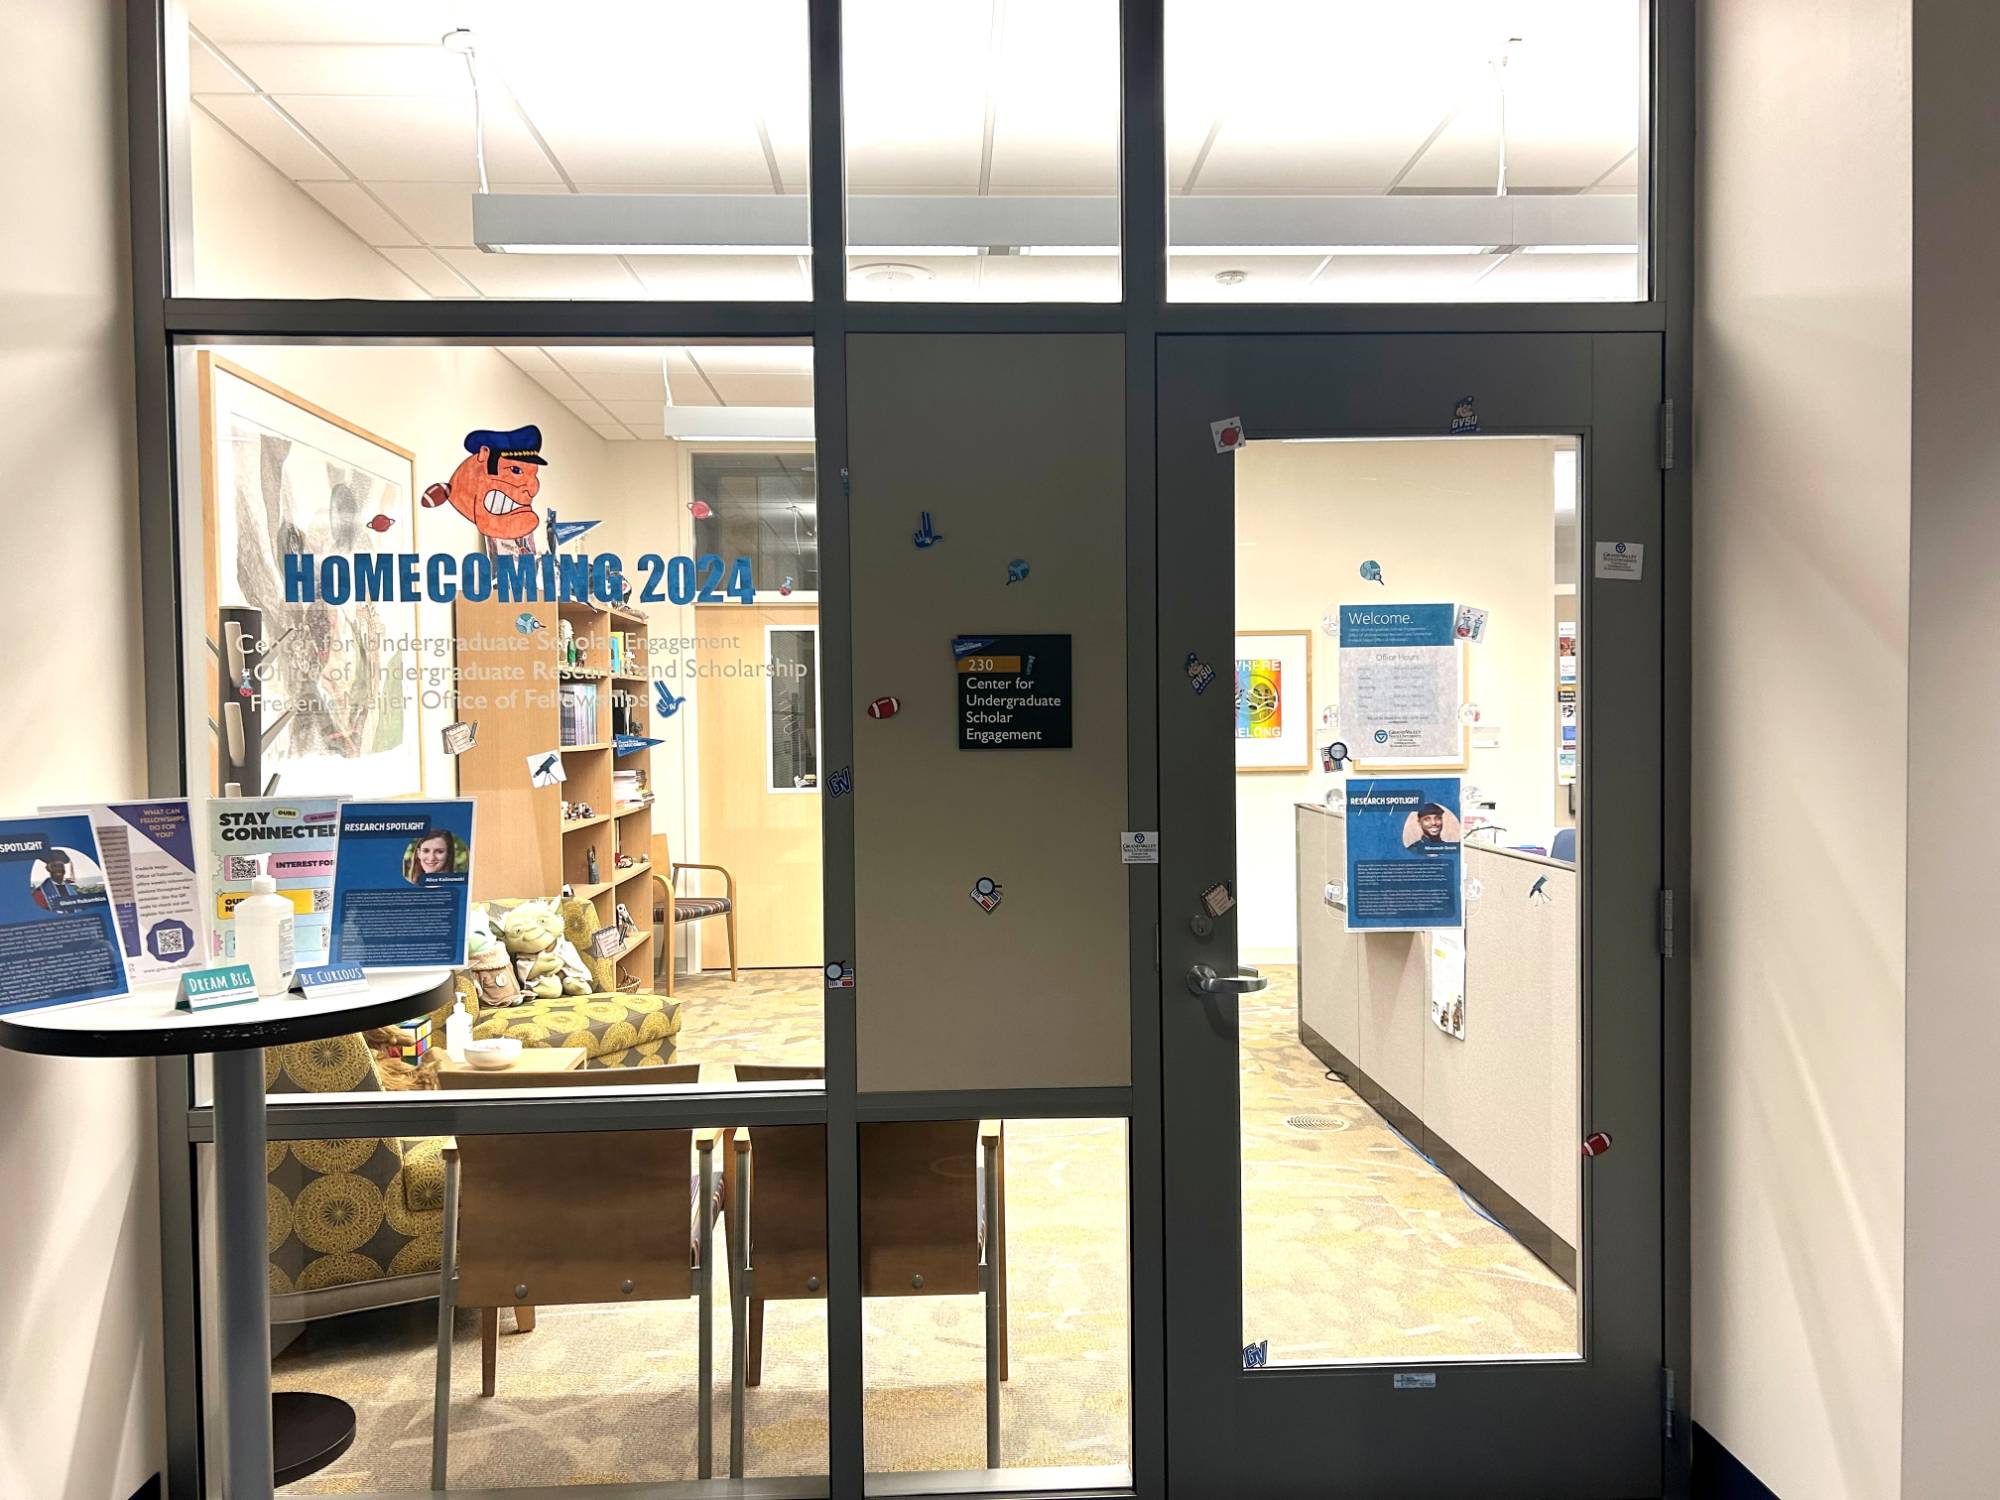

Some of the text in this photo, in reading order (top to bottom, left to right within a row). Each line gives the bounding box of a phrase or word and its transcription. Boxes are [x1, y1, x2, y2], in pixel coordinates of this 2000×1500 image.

[1452, 416, 1478, 428] GVSU
[284, 552, 756, 605] HOMECOMING 2024
[1349, 612, 1414, 625] Welcome.
[323, 633, 354, 653] for
[363, 632, 528, 662] Undergraduate
[537, 630, 611, 651] Scola
[625, 632, 740, 656] Engagement
[330, 662, 351, 681] of
[364, 662, 526, 687] ndergraduate
[533, 660, 634, 682] Resear
[685, 655, 808, 683] Scholarship
[968, 659, 993, 671] 230
[966, 677, 1034, 689] Center for
[1192, 664, 1212, 689] GVSU
[421, 690, 487, 710] Office
[495, 690, 519, 709] of
[525, 689, 648, 715] Felowhips
[966, 694, 1061, 709] Undergraduate
[966, 711, 1013, 723] Scholar
[966, 728, 1042, 743] Engagement
[1235, 727, 1281, 737] ELONG
[1350, 796, 1419, 805] RESEARCH SPOTLIGHT
[143, 807, 181, 816] WHAT CAN
[139, 815, 186, 824] FELLOWSHIPS
[219, 811, 271, 826] STAY
[344, 822, 425, 832] RESEARCH SPOTLIGHT
[155, 831, 174, 839] YOU?
[0, 840, 43, 853] SPOTLIGHT
[276, 860, 317, 869] INTEREST
[189, 972, 251, 992] DREAM BIG
[301, 967, 362, 985] BE CURIOUS
[1243, 1339, 1268, 1367] GV
